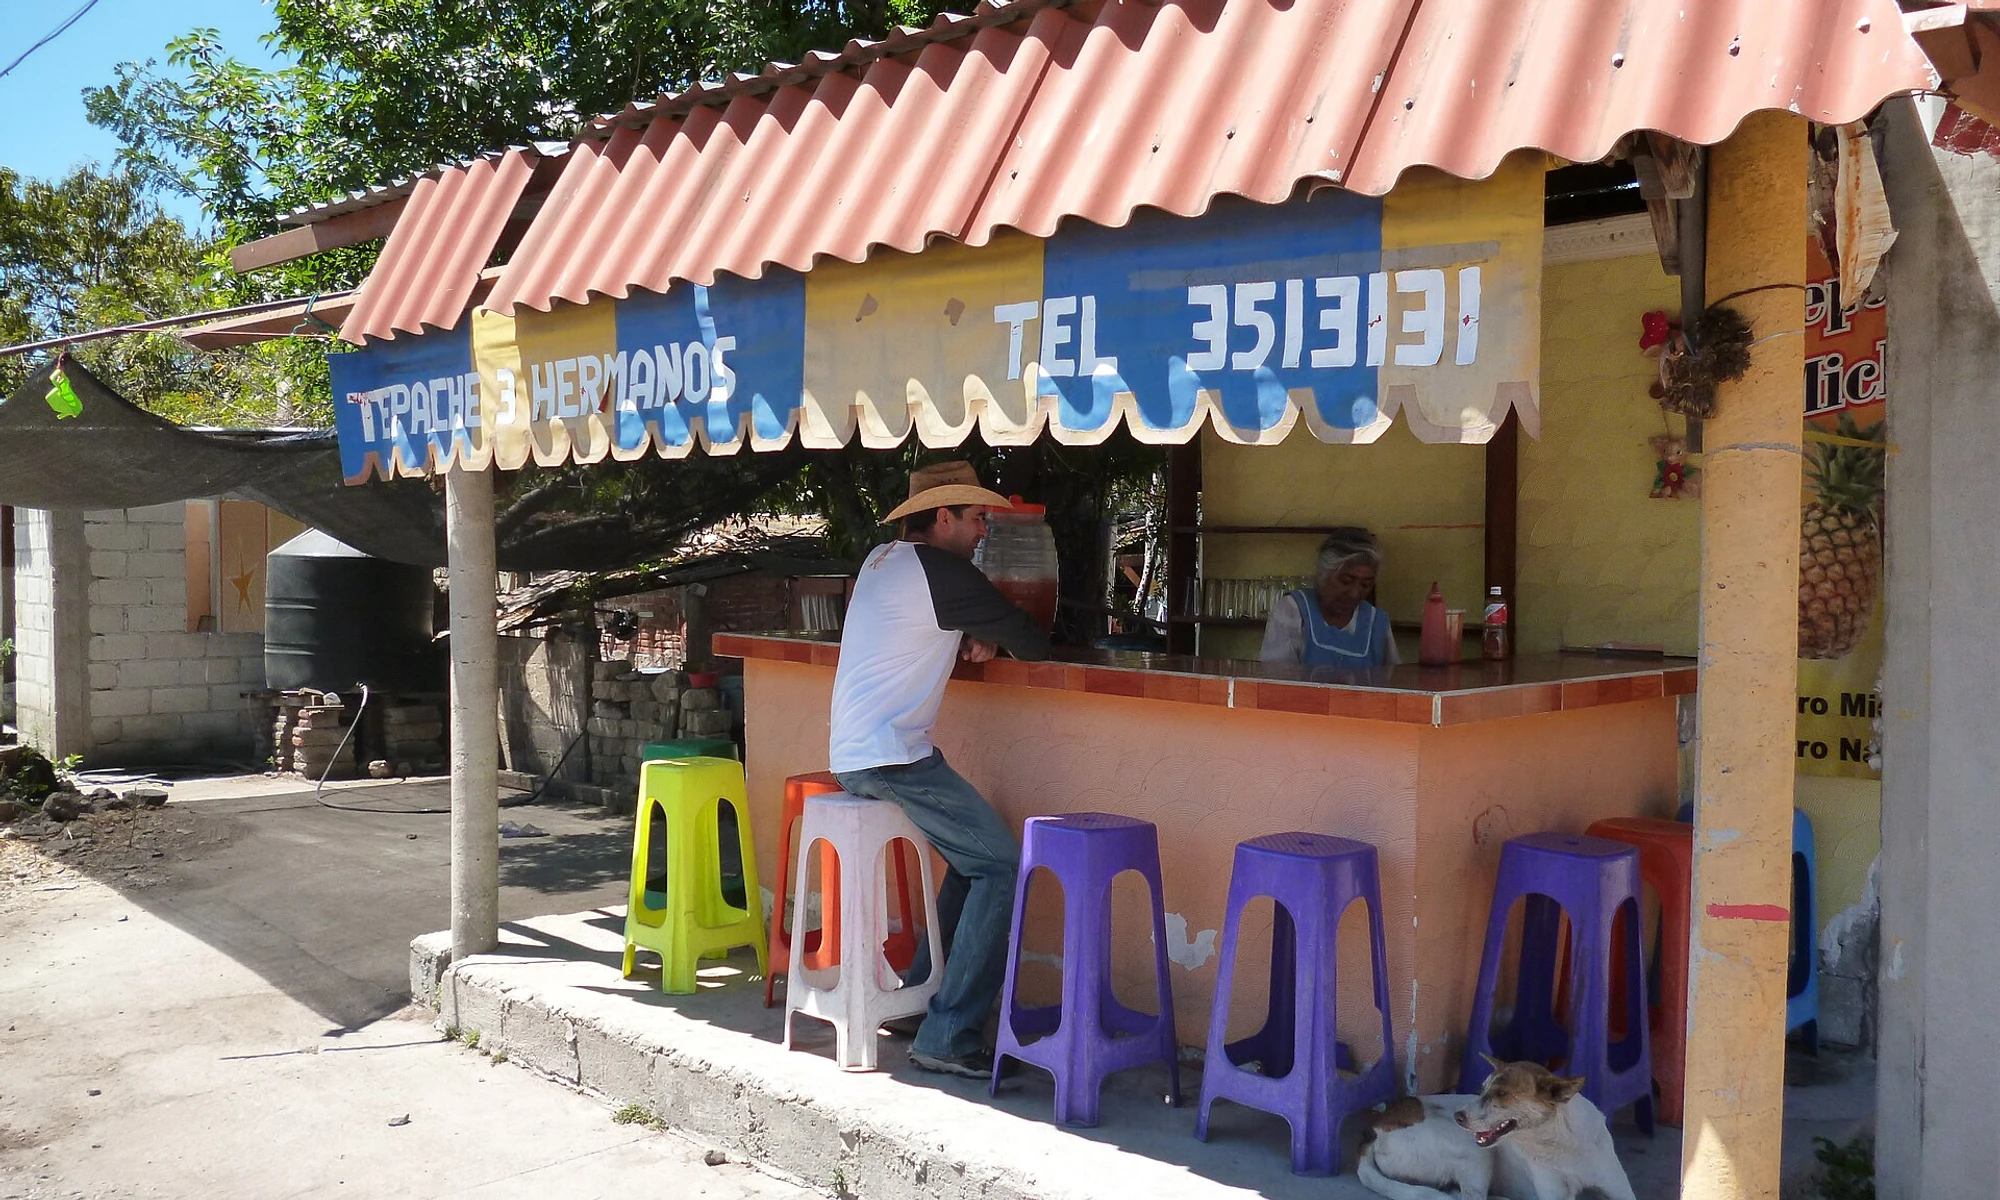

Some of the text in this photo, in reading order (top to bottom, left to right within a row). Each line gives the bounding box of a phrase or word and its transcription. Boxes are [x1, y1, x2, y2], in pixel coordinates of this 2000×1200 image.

[994, 265, 1482, 381] TEL 3513131
[346, 335, 737, 443] TEPACHE 3 HERMANOS
